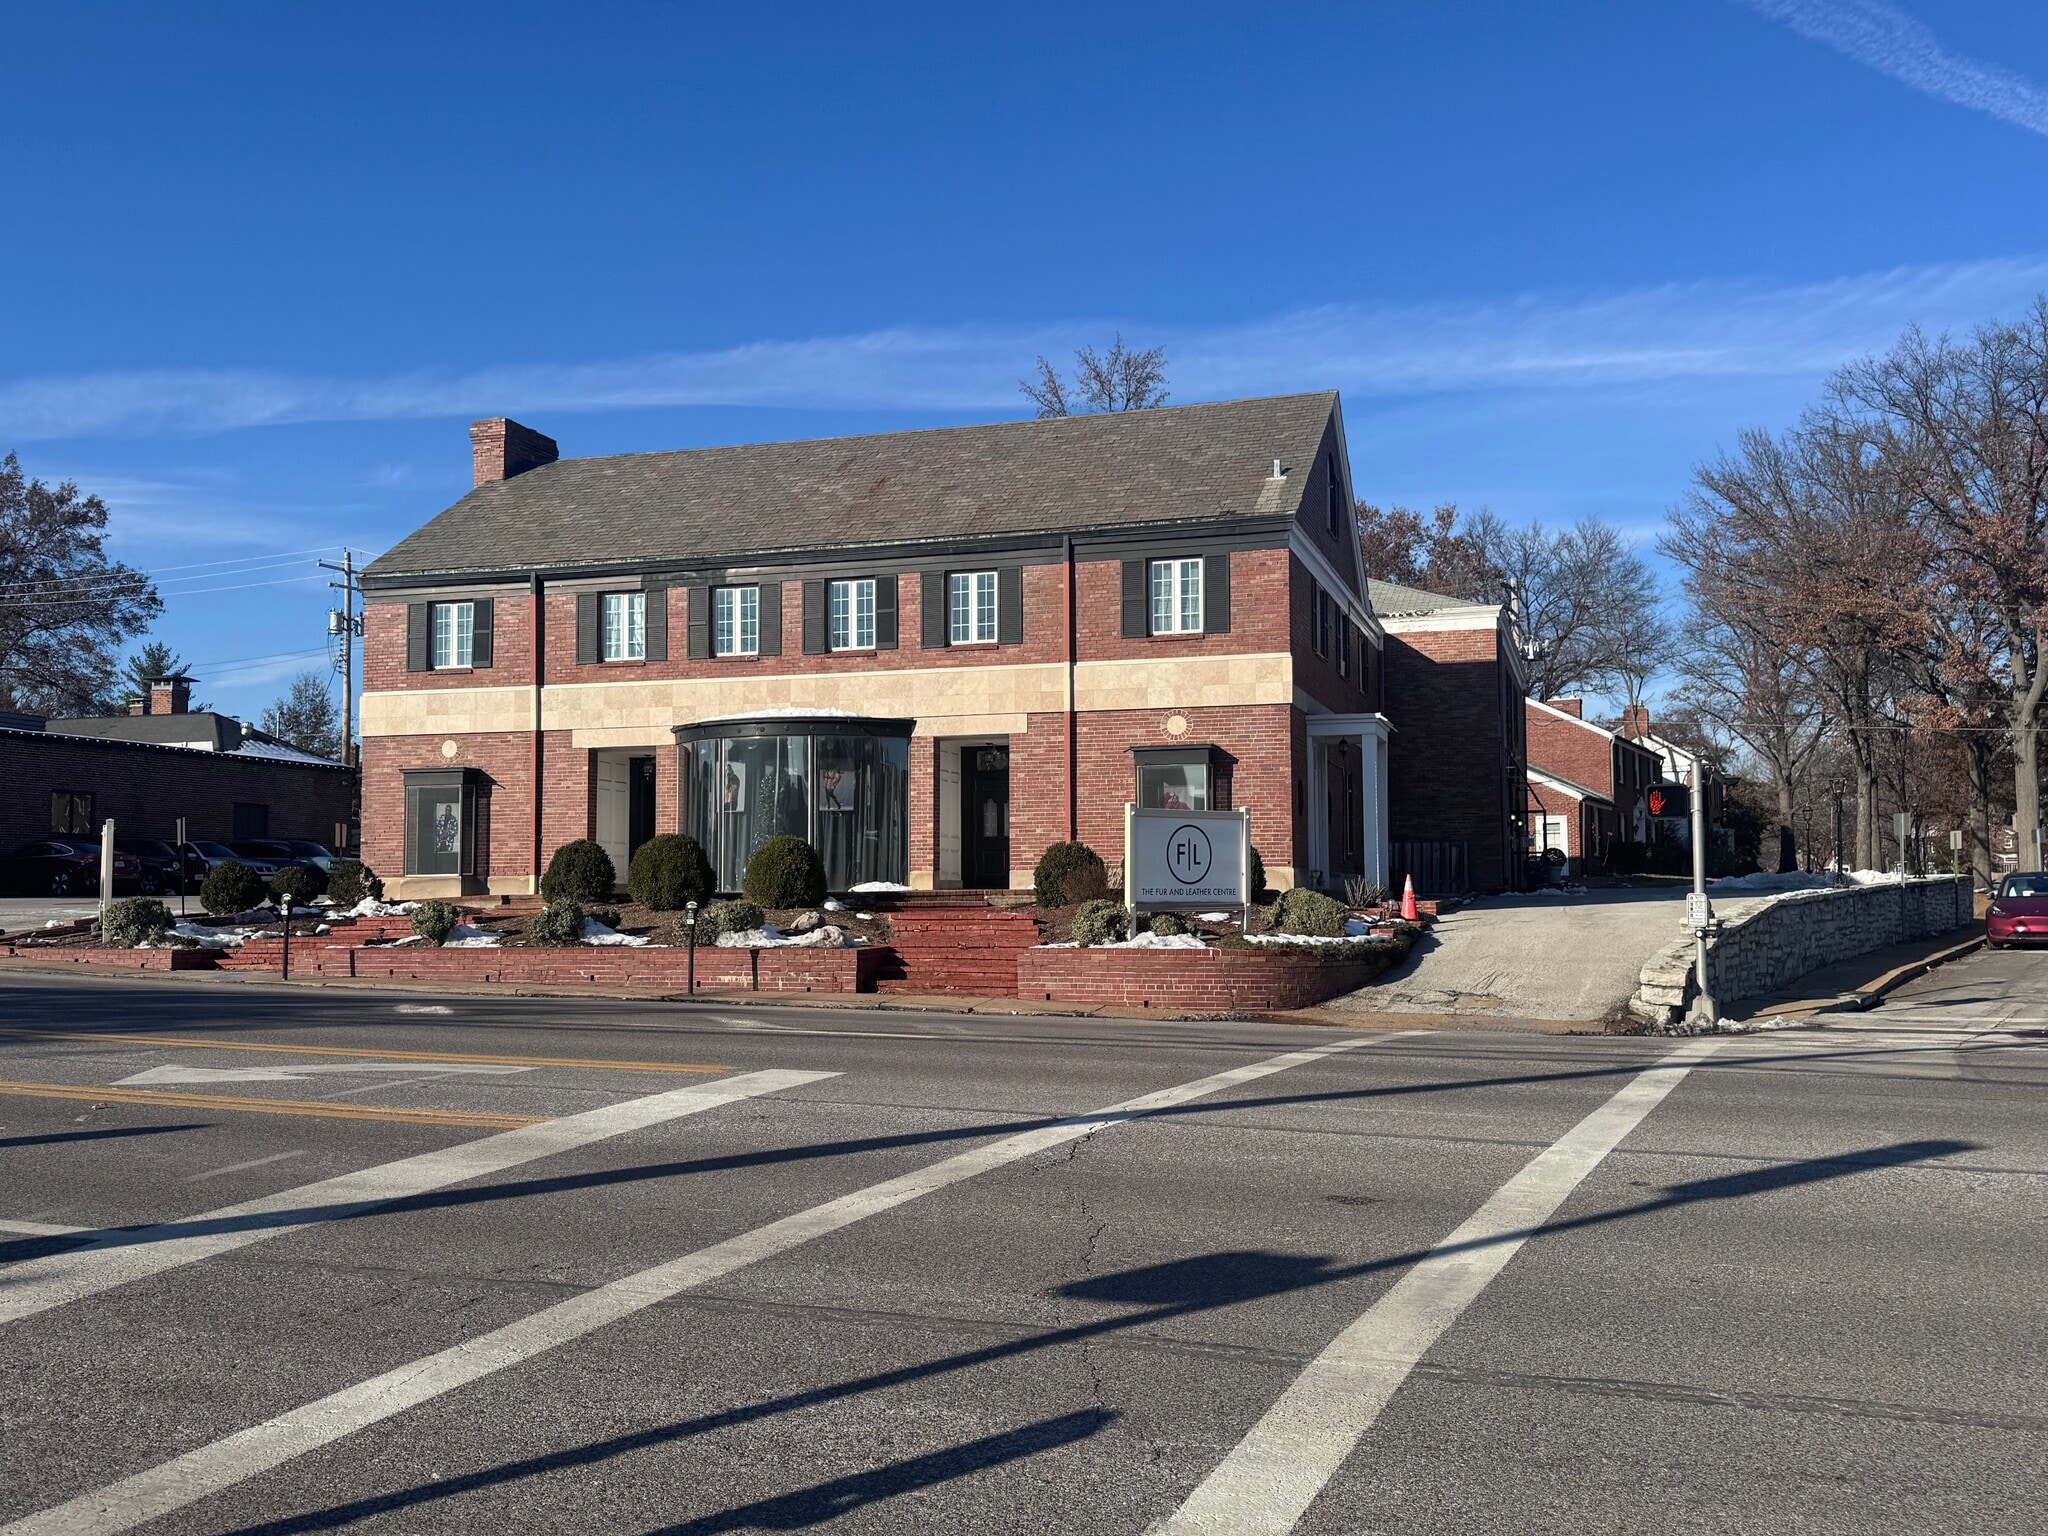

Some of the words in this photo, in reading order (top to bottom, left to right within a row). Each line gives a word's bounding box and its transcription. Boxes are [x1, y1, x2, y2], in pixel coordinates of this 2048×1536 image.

[1142, 888, 1154, 896] THE
[1155, 888, 1168, 896] FUR
[1169, 888, 1184, 896] AND
[1185, 888, 1212, 896] LEATHER
[1212, 888, 1236, 896] CENTRE
